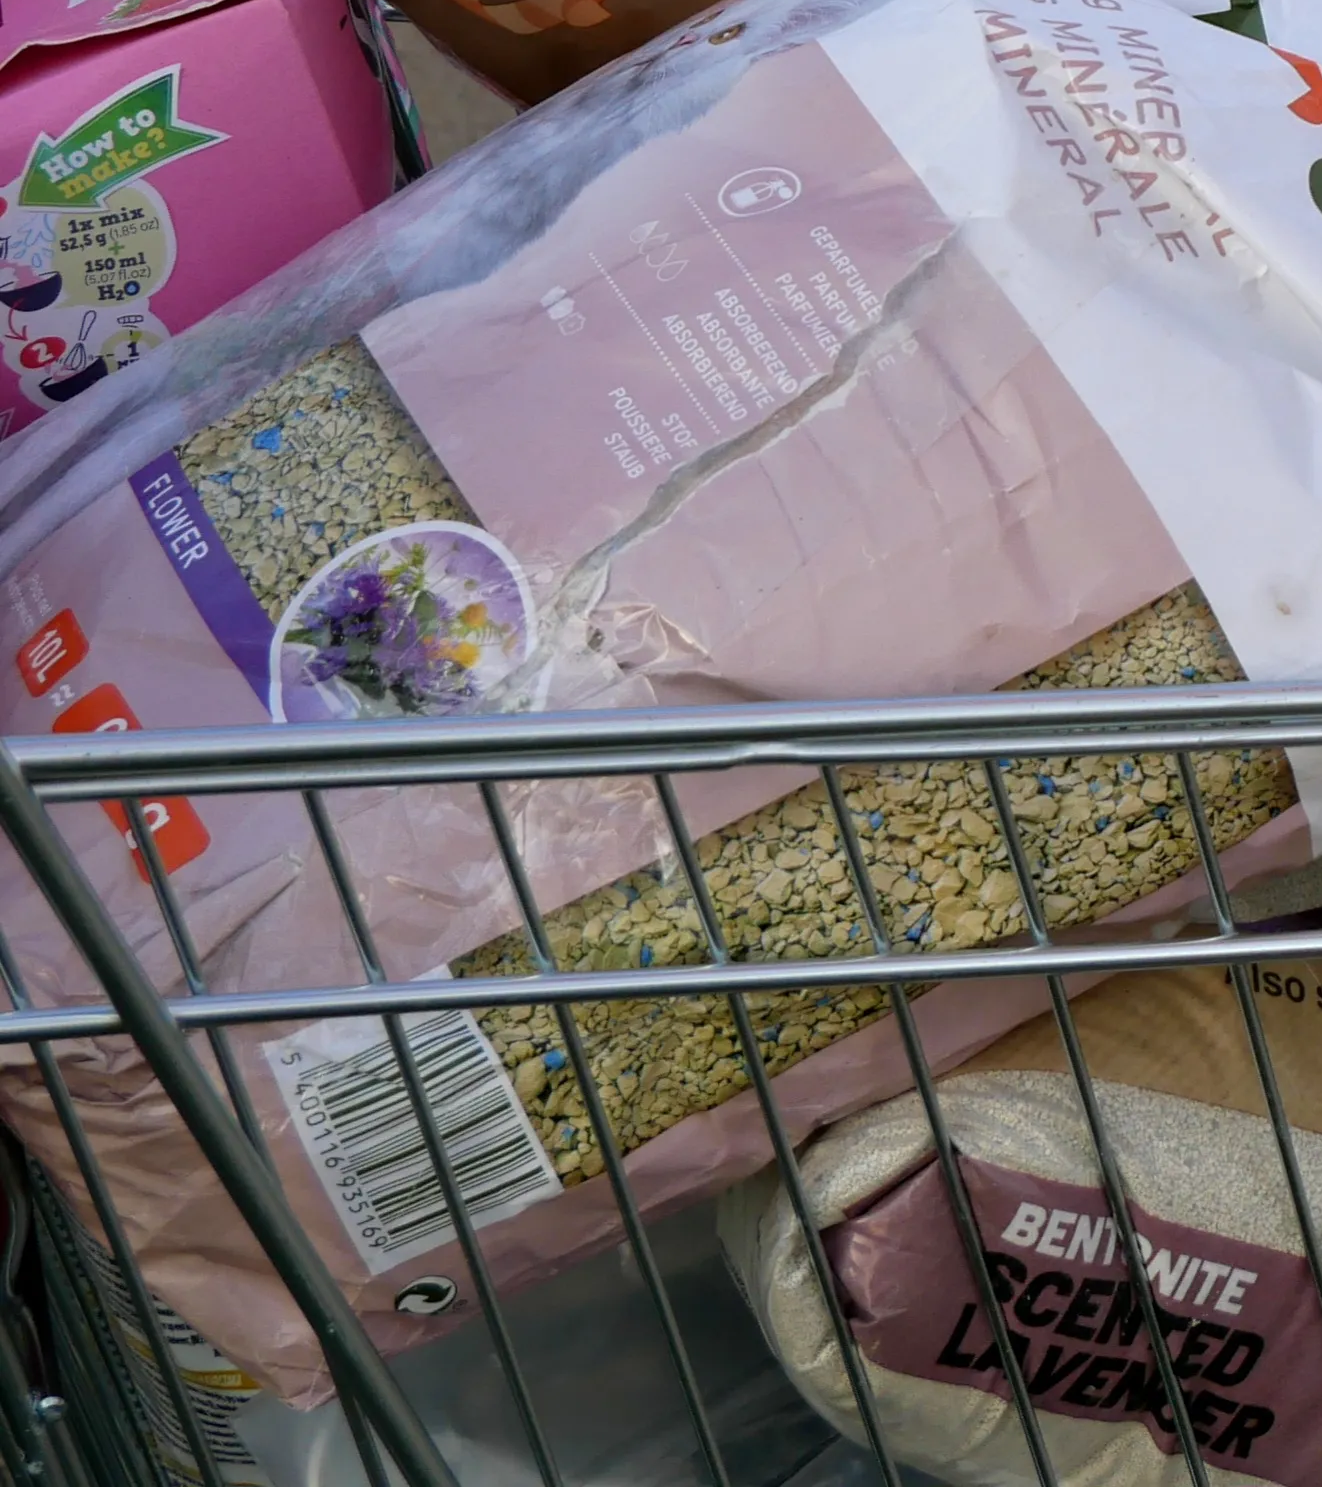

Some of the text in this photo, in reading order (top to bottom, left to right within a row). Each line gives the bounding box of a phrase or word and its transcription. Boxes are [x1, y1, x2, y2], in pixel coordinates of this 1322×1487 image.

[40, 108, 156, 184] How to
[57, 128, 168, 199] make?
[977, 9, 1122, 239] MINERAL
[60, 217, 160, 253] 52,5 g oz)
[68, 207, 146, 234] 1x mix
[85, 252, 147, 273] 150 ml
[660, 313, 749, 424] ABSORBIEREND
[696, 311, 777, 411] ABSORBANTE
[713, 287, 801, 396] ABSORBEREND
[604, 432, 646, 481] STAUB
[607, 386, 674, 467] POUSSIERE
[142, 471, 211, 571] FLOWER
[982, 1250, 1265, 1388] SCENTED
[937, 1303, 1276, 1459] LAVENDER
